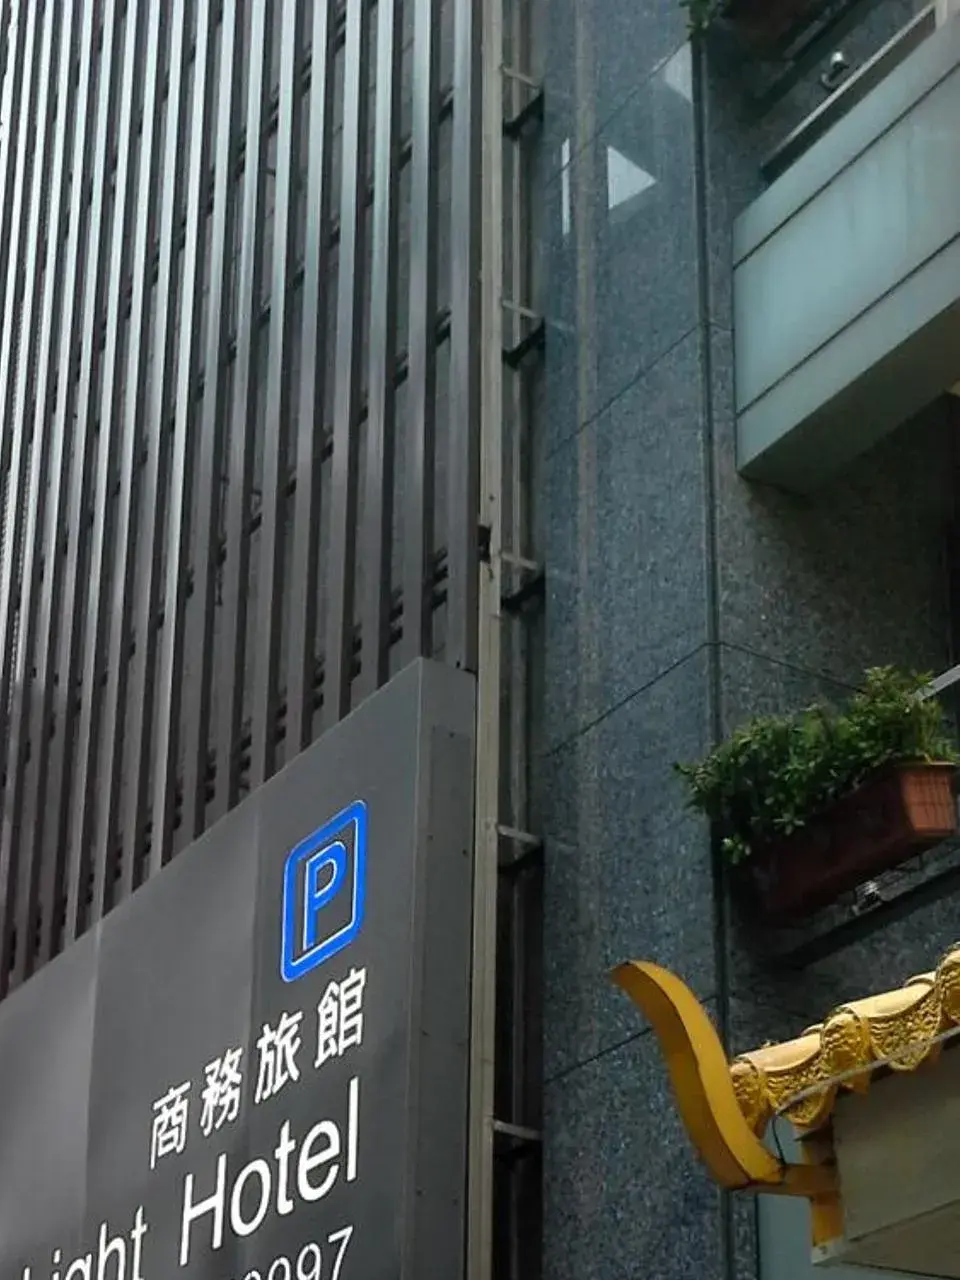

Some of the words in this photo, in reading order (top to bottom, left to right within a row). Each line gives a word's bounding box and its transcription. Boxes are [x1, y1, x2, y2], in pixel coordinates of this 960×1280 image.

[302, 840, 347, 954] P
[149, 966, 368, 1170] 商務旅館
[178, 1078, 360, 1267] Hotel
